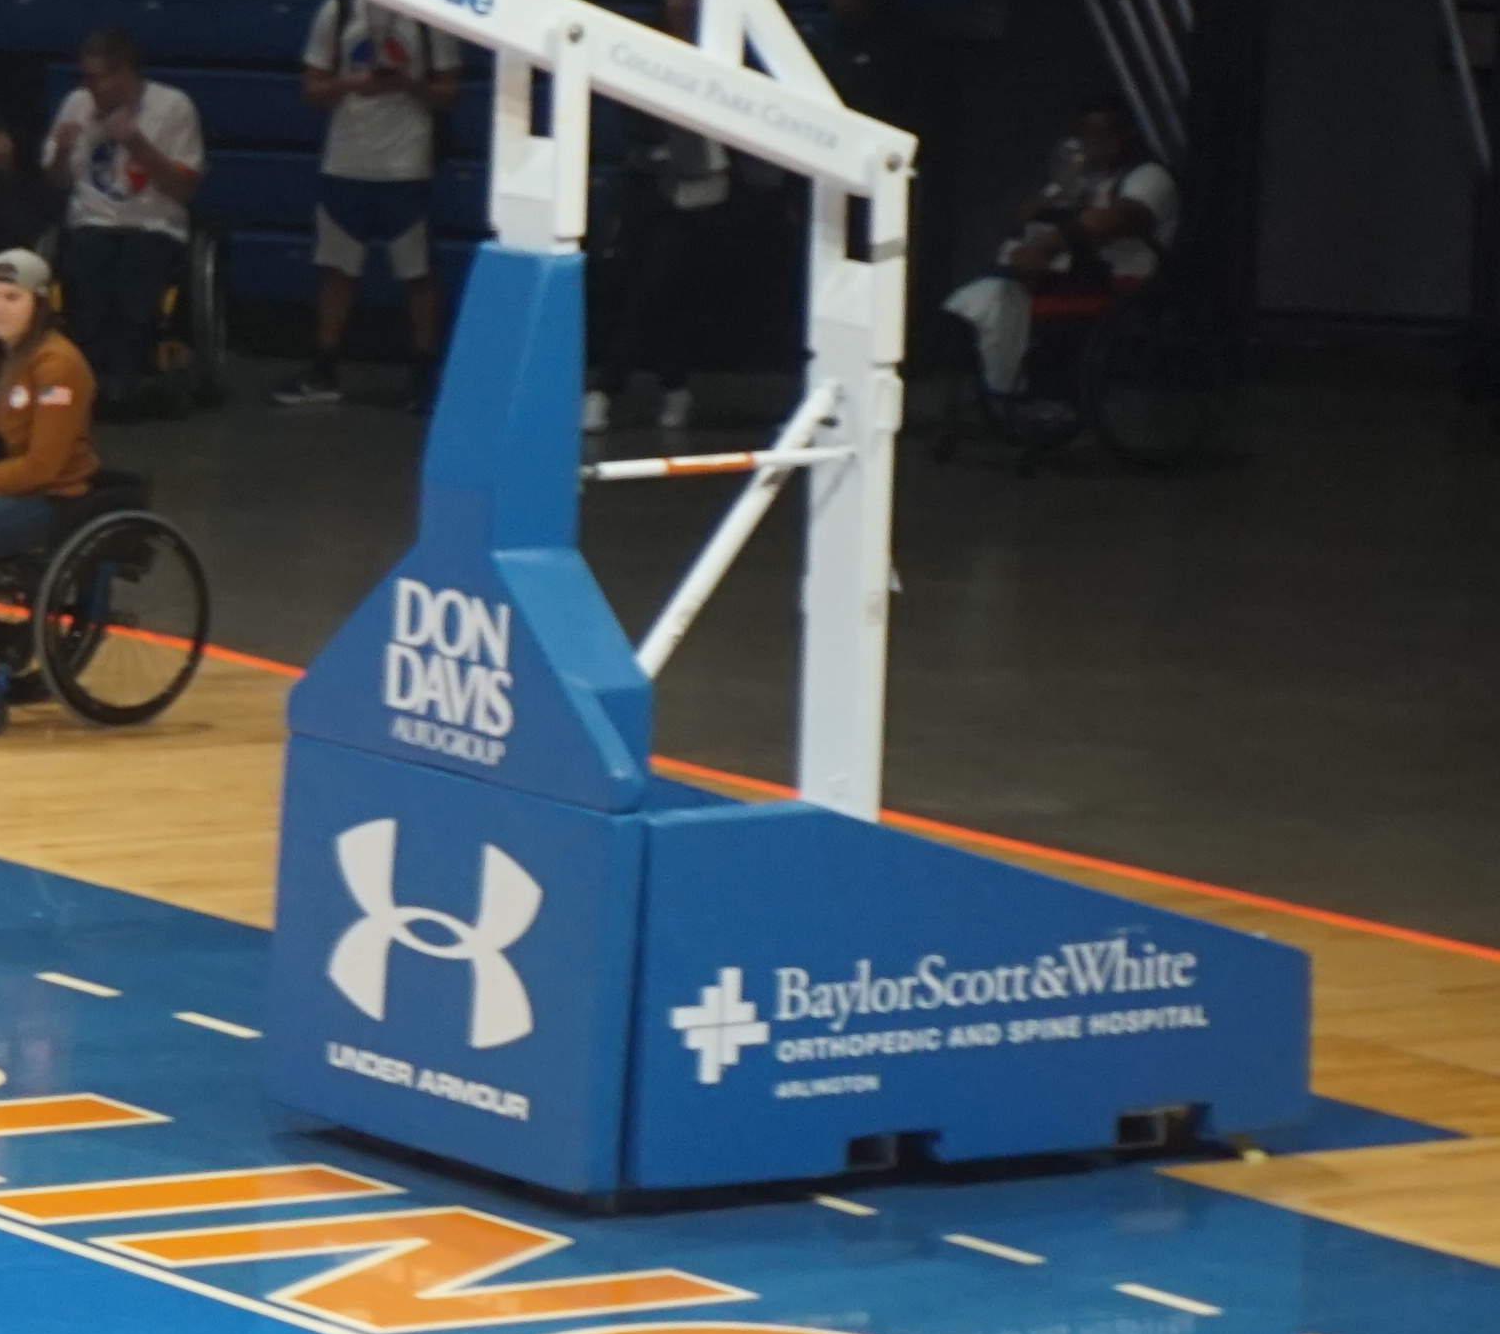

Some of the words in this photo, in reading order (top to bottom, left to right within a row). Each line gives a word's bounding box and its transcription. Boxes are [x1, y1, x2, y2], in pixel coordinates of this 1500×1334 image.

[392, 577, 512, 668] DON
[384, 642, 514, 737] DAVIS
[775, 1028, 942, 1064] ORTHOPEDIC
[947, 1020, 1003, 1050] AND
[1007, 1015, 1083, 1046] SPINE
[1088, 1004, 1210, 1036] HOSPITAL
[327, 1040, 415, 1088] UNDER
[417, 1061, 530, 1121] ARMOUR
